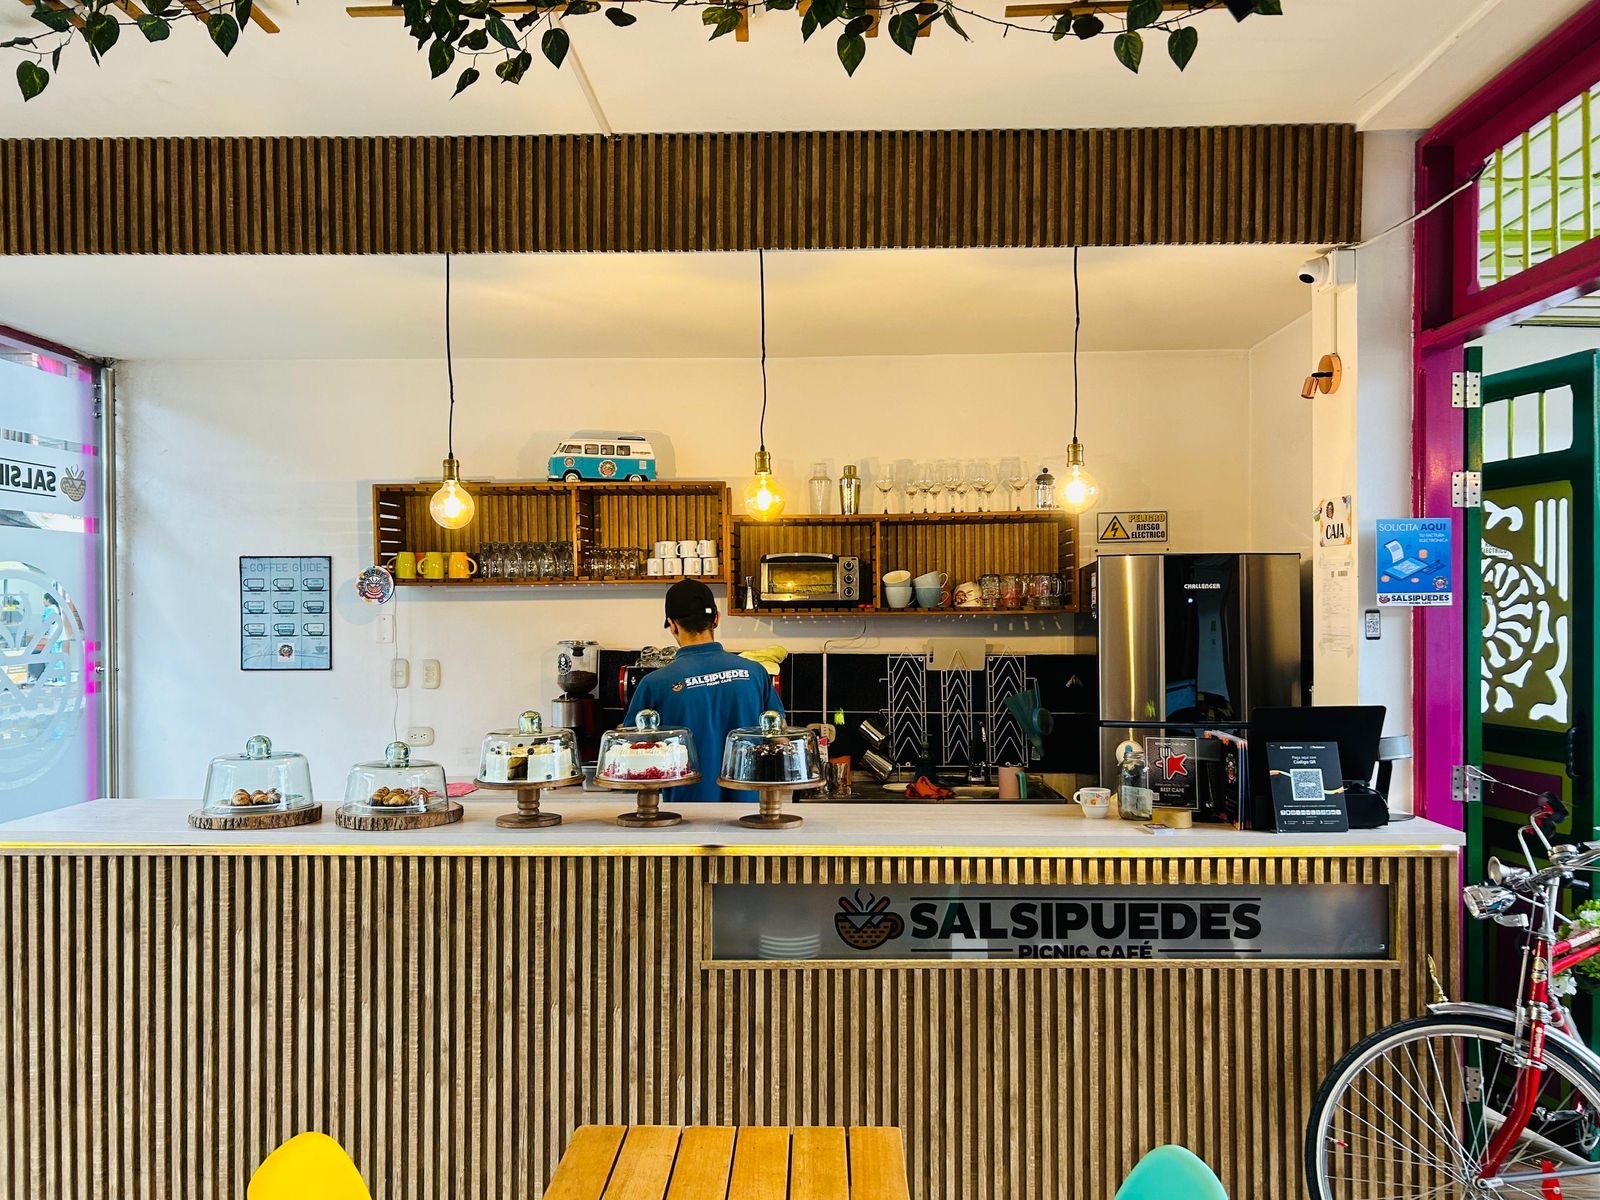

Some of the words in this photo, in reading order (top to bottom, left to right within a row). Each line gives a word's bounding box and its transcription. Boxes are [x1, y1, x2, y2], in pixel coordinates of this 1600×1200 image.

[1128, 514, 1165, 522] PELIGRO
[1136, 523, 1160, 531] RIESGO
[1325, 522, 1345, 540] CAJA
[1378, 523, 1419, 532] SOLICITA
[1420, 522, 1447, 532] AQUI
[1131, 531, 1166, 539] ELECTRICO
[249, 562, 289, 573] COFFEE
[291, 562, 323, 573] GUIDE
[1391, 594, 1450, 602] SALSIPUEDES
[684, 668, 750, 687] SALSIPUEDES
[910, 902, 1262, 940] SALSIPUEDES
[1018, 944, 1090, 959] PICNIC
[1095, 940, 1153, 959] CAFÉ
